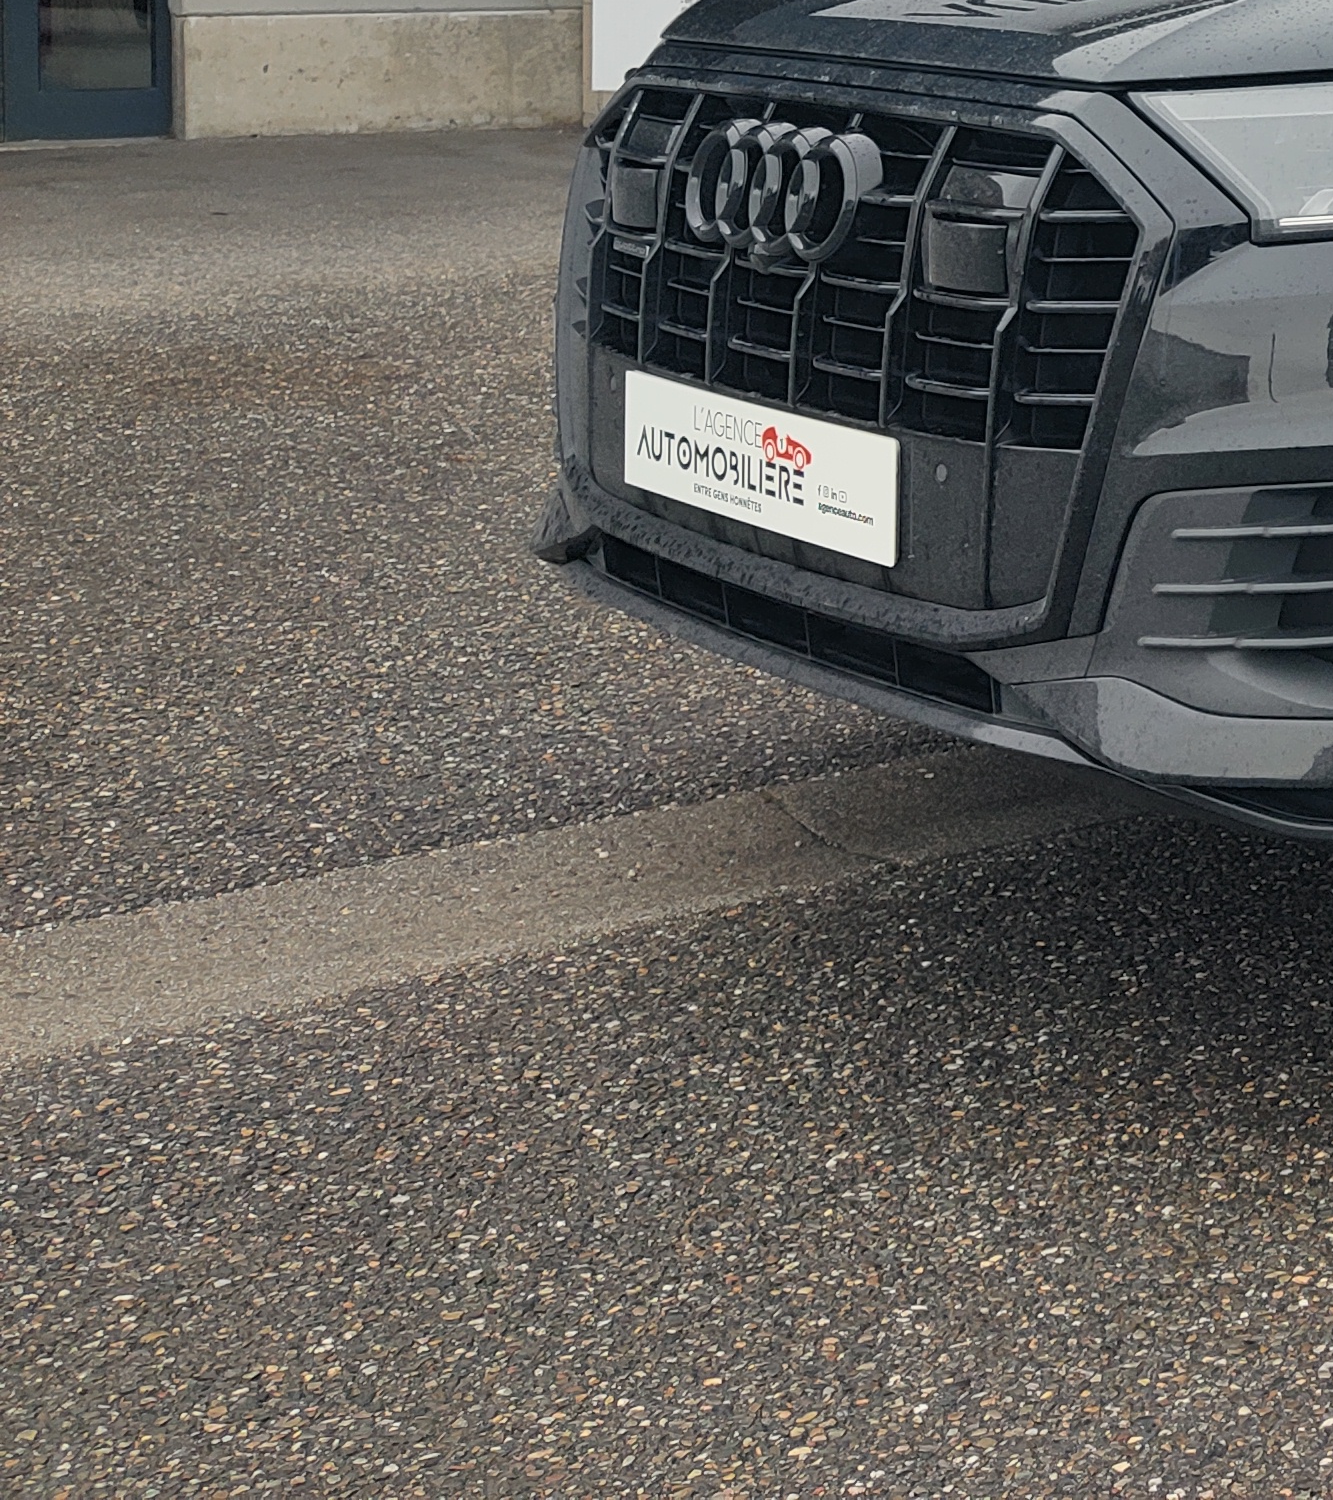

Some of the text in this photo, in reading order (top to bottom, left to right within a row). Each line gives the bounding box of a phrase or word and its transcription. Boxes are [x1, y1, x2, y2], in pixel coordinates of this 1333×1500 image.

[693, 482, 712, 498] ENTRE
[713, 488, 729, 503] GENS
[818, 503, 874, 526] agenceauto.com
